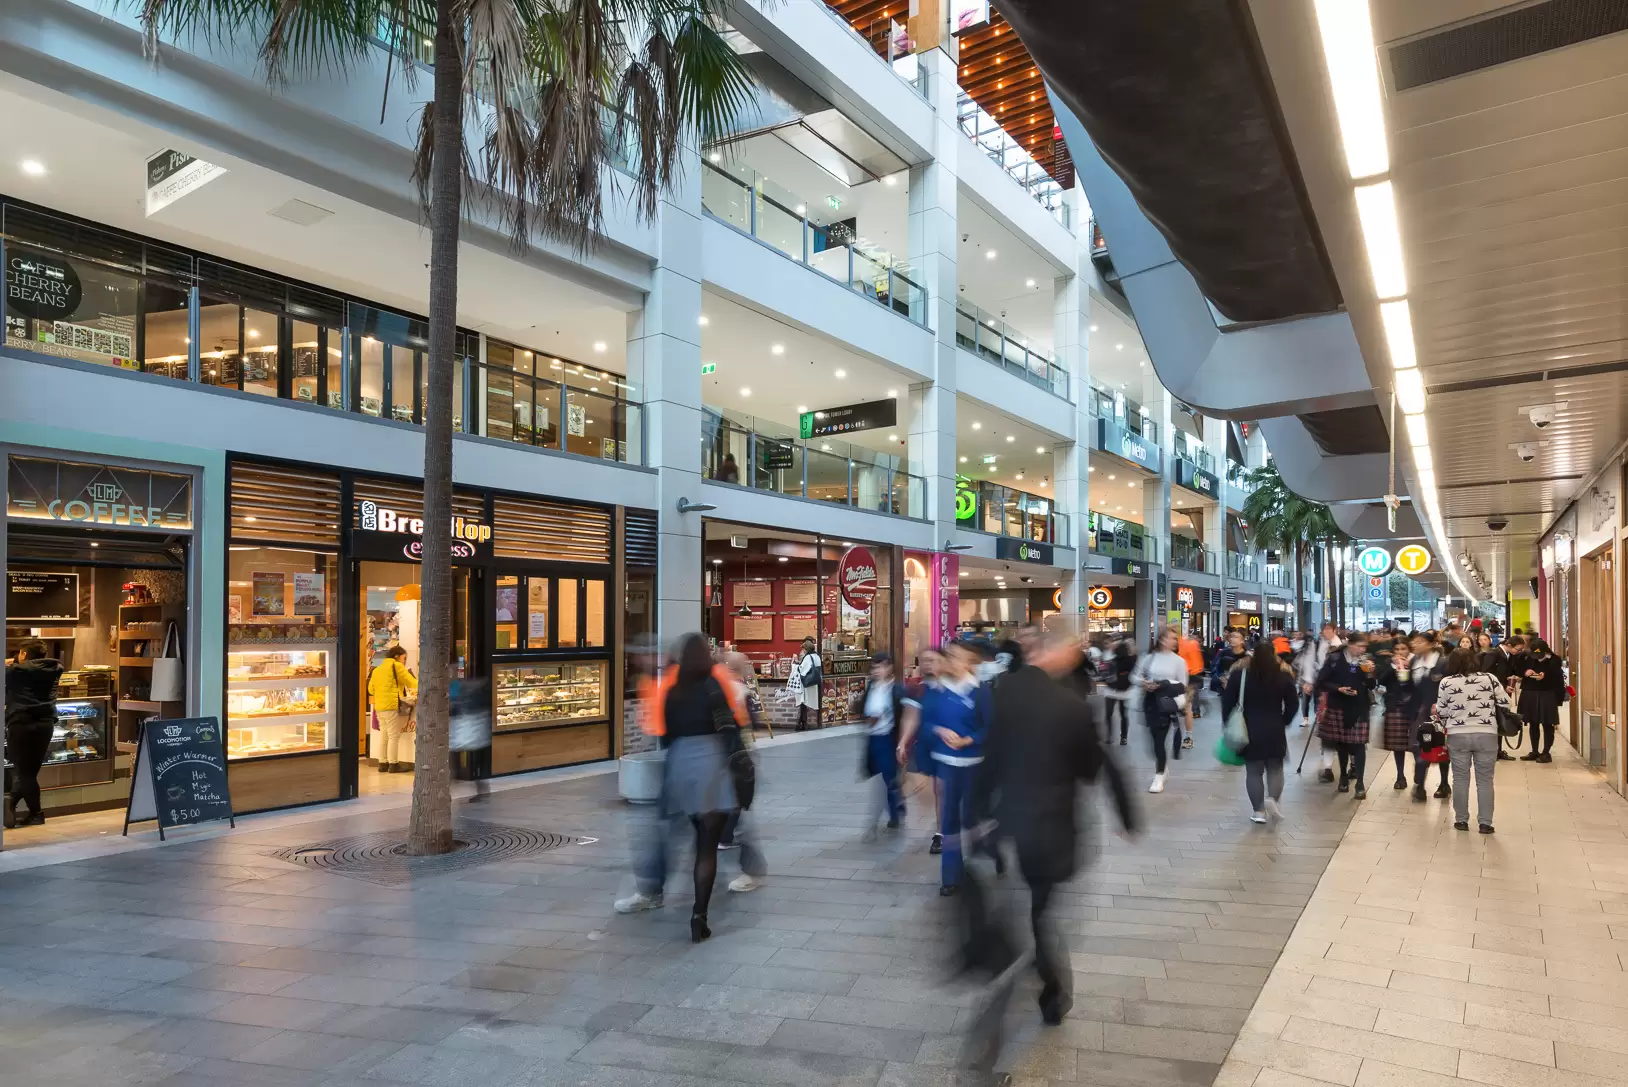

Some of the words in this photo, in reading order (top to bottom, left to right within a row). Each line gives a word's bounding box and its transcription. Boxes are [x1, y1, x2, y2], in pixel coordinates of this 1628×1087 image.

[11, 257, 65, 280] CAFFE
[5, 269, 73, 296] CHERRY
[9, 284, 67, 308] BEANS
[801, 415, 808, 431] G
[1131, 441, 1147, 461] Metro
[1199, 475, 1211, 491] Metro
[48, 499, 162, 528] COFFEE
[378, 509, 491, 543] Bretop
[1027, 548, 1041, 560] Metro
[1365, 553, 1383, 569] M
[1405, 551, 1421, 569] T
[1132, 564, 1141, 574] Metro
[833, 660, 857, 673] MOMENTS
[157, 736, 192, 744] LOCOMOTION
[156, 754, 181, 773] Winter
[183, 750, 217, 762] Warmer
[192, 770, 207, 781] Hot
[191, 782, 211, 793] Mgic
[194, 792, 220, 801] Matcha
